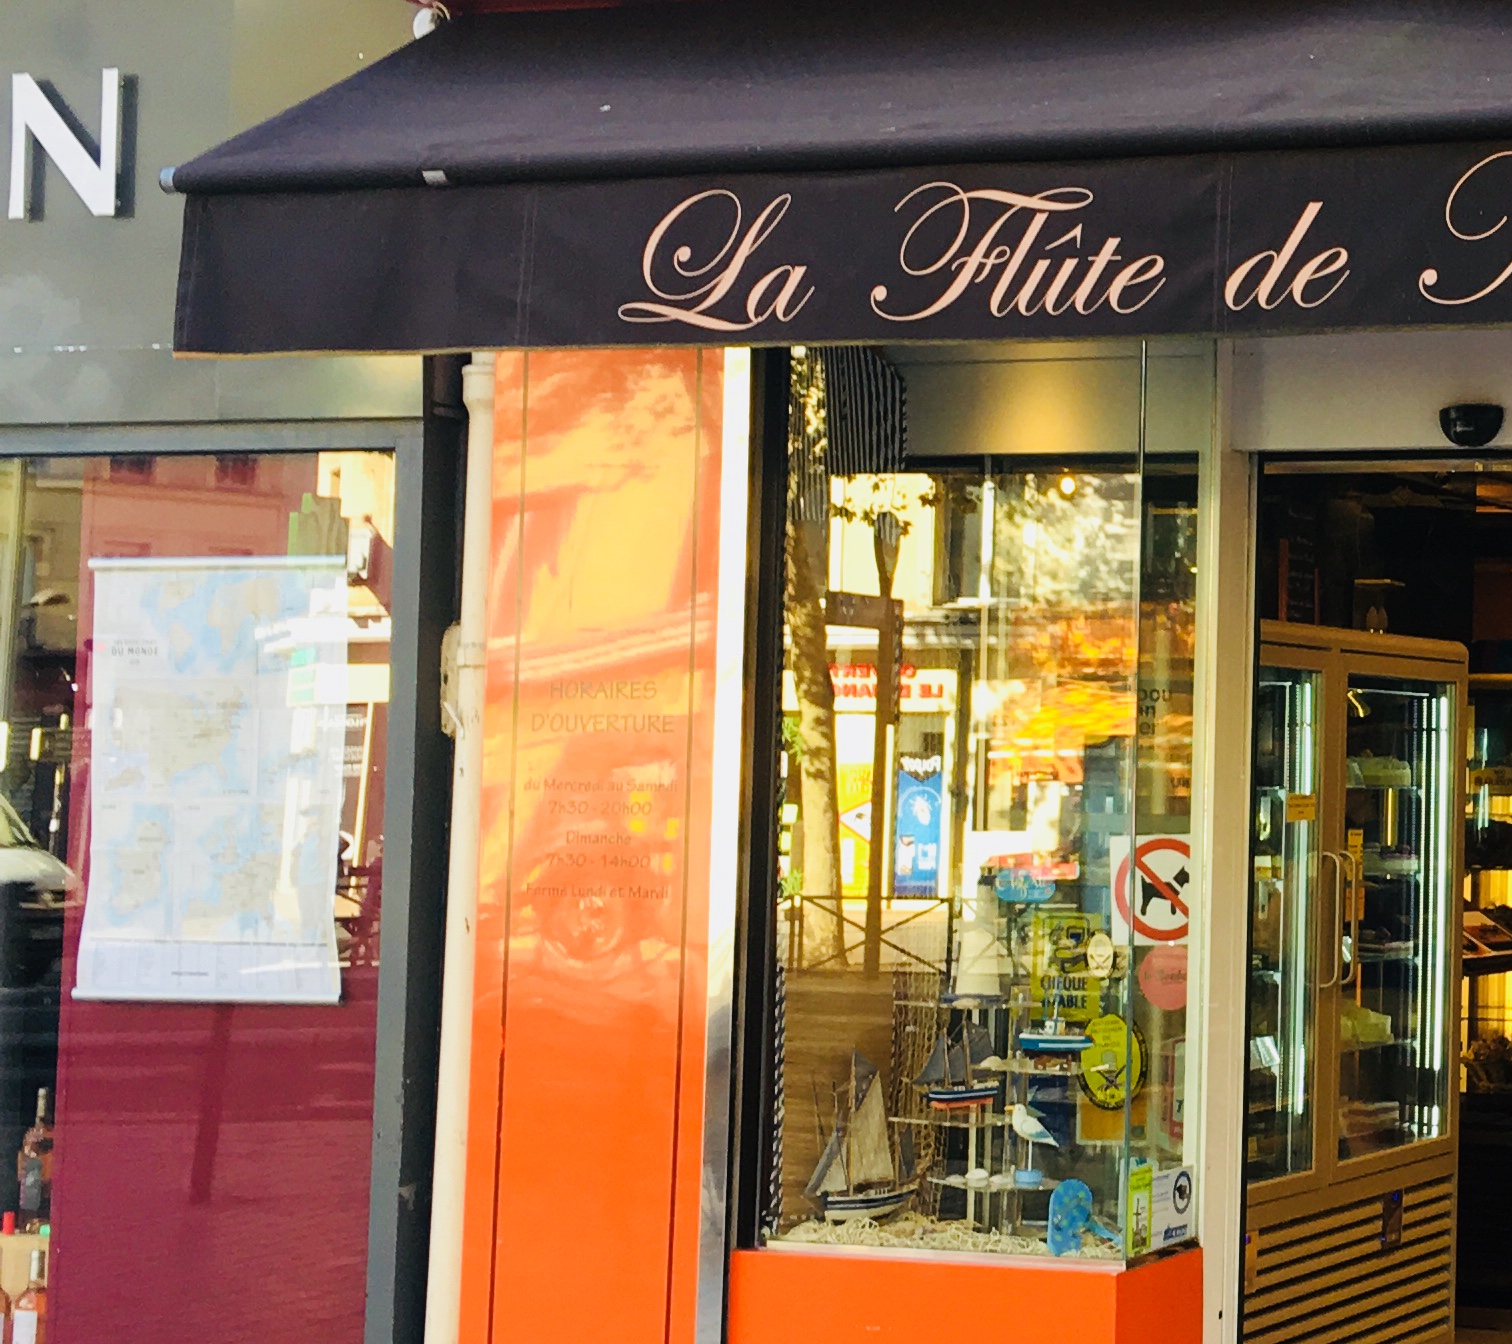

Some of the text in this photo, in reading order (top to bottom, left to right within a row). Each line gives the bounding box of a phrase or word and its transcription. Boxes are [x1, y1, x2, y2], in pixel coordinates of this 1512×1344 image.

[618, 189, 815, 331] La
[871, 181, 1167, 321] Flûte
[1224, 201, 1350, 311] de
[549, 680, 658, 700] HORAIRES
[531, 712, 675, 734] D'OUVERTURE
[549, 800, 589, 815] 7h30
[565, 830, 632, 846] Dimanche
